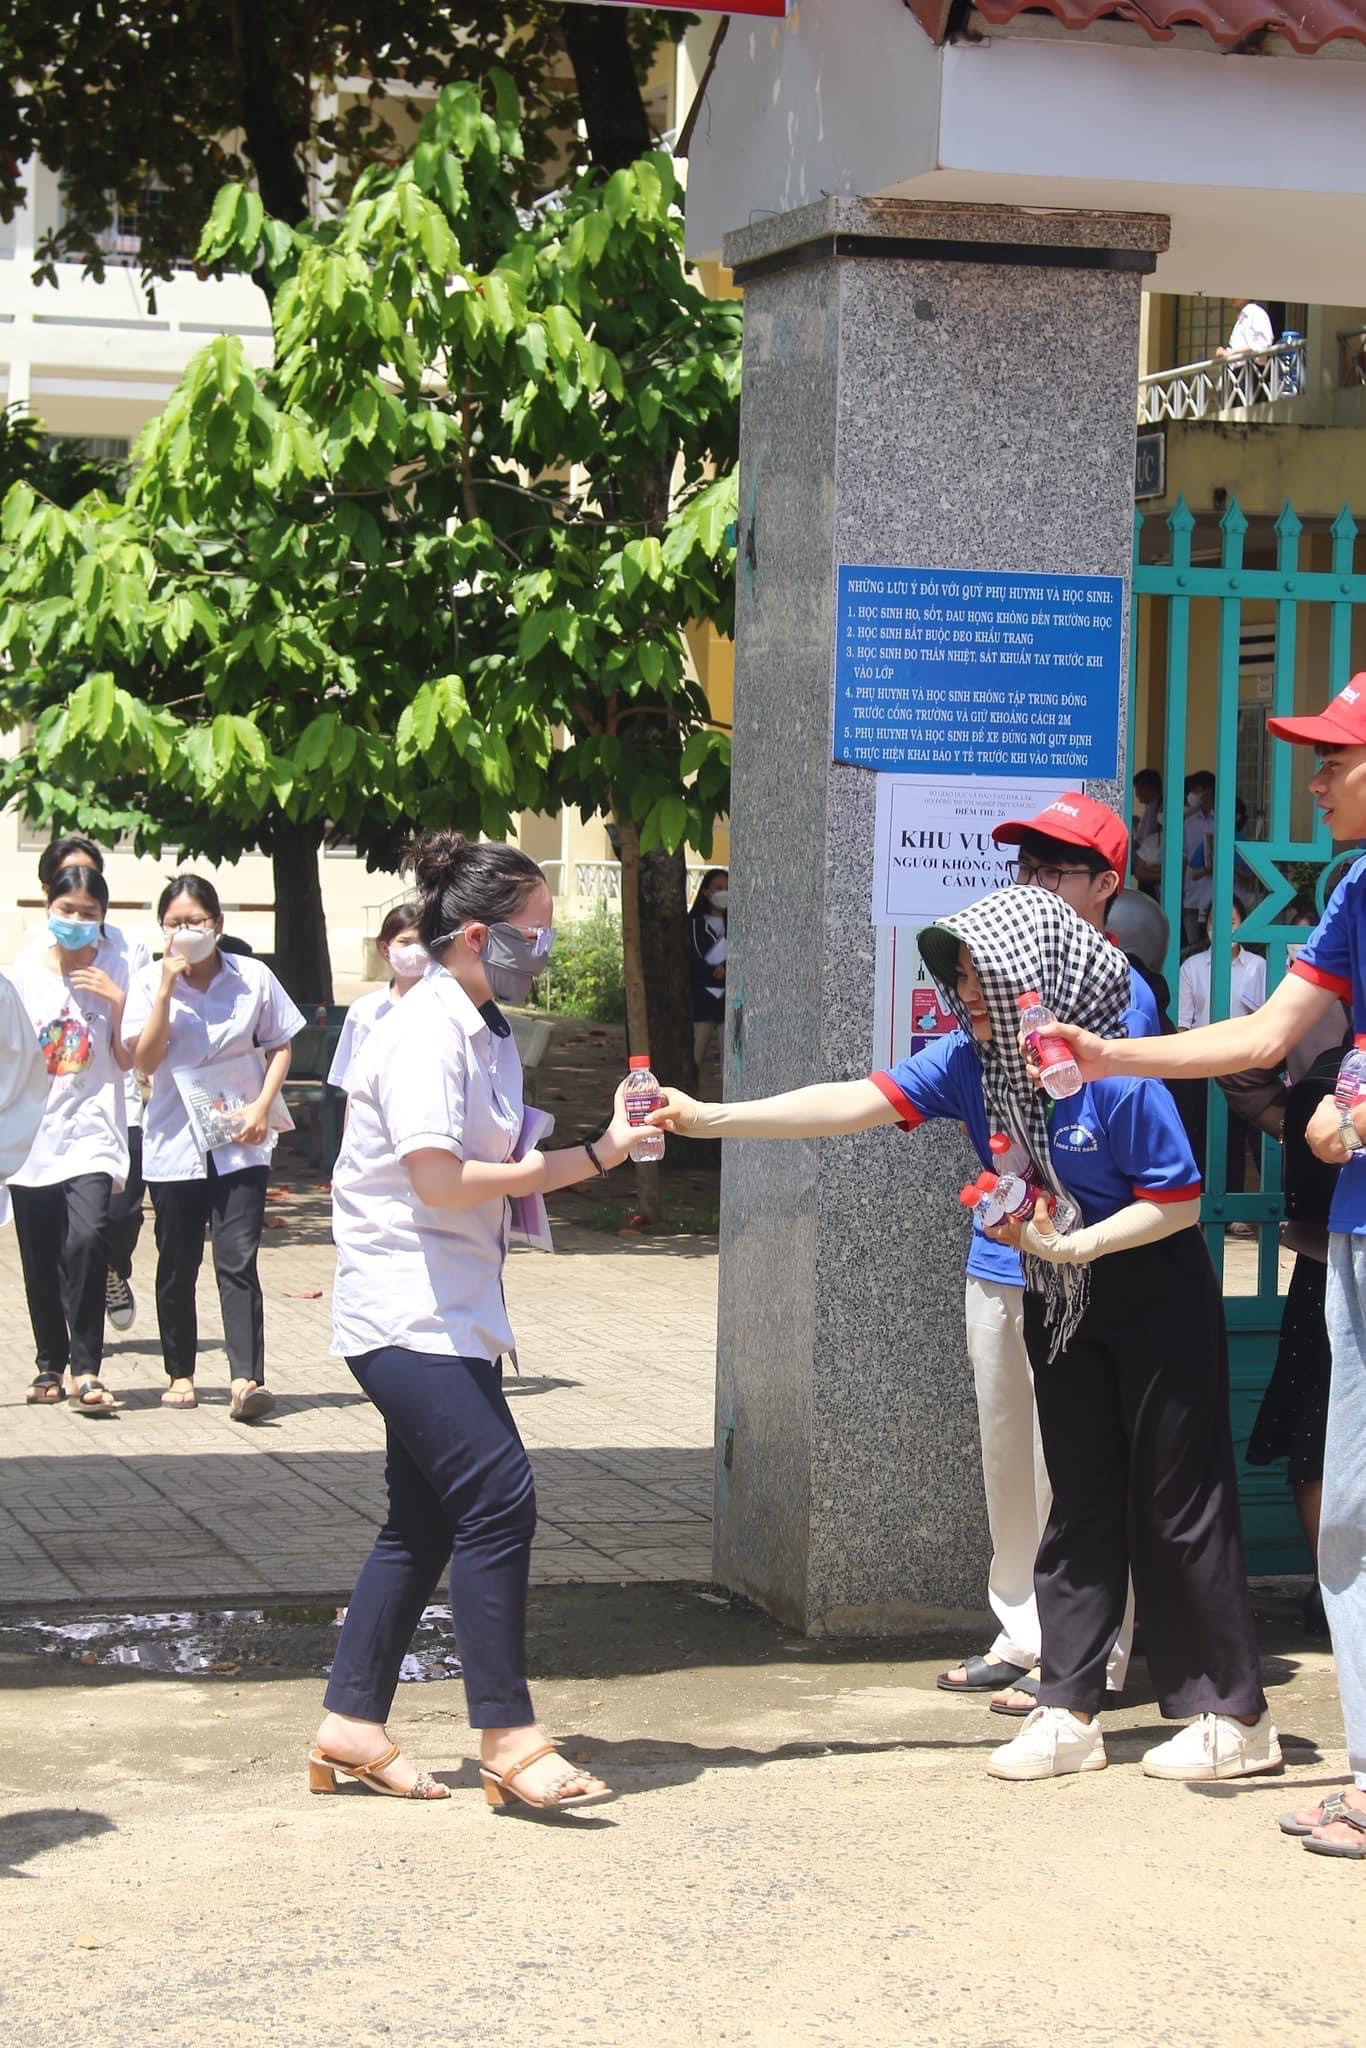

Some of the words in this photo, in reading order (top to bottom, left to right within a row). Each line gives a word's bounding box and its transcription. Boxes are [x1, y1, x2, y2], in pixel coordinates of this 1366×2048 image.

[848, 577, 884, 593] NHỮNG
[887, 580, 908, 595] LƯU
[911, 579, 918, 595] Ý
[920, 577, 939, 596] ĐỐI
[942, 580, 959, 597] VỚI
[962, 582, 983, 600] QUÝ
[986, 586, 1006, 602] PHỤ
[1009, 587, 1044, 600] HUYNH
[1047, 585, 1060, 601] VÀ
[1063, 589, 1084, 605] HỌC
[1087, 591, 1113, 603] SINH:
[848, 606, 855, 617] 1.
[858, 606, 878, 621] HỌC
[881, 608, 902, 619] SINH
[905, 608, 921, 621] HO,
[924, 604, 943, 622] SỐT,
[946, 610, 965, 622] ĐAU
[968, 611, 993, 626] HỌNG
[996, 610, 1029, 625] KHÔNG
[1031, 608, 1050, 625] ĐẾN
[1053, 612, 1090, 627] TRƯỜNG
[1093, 616, 1112, 631] HỌC
[846, 626, 855, 638] 2.
[857, 627, 878, 641] HỌC
[880, 628, 902, 639] SINH
[904, 622, 923, 640] BẮT
[925, 627, 951, 644] BUỘC
[953, 630, 972, 642] ĐEO
[975, 626, 1000, 643] KHẨU
[1003, 632, 1034, 645] TRANG
[846, 646, 855, 658] 3.
[857, 647, 877, 662] HỌC
[880, 648, 902, 659] SINH
[904, 648, 918, 660] ĐO
[920, 646, 945, 661] THÂN
[980, 648, 998, 663] SÁT
[1000, 647, 1032, 665] KHUẨN
[1034, 654, 1052, 665] TAY
[1053, 651, 1084, 666] TRƯỚC
[1086, 655, 1103, 667] KHI
[854, 664, 873, 679] VÀO
[875, 664, 894, 679] LỚP
[845, 687, 854, 698] 4.
[856, 687, 874, 702] PHỤ
[877, 688, 909, 700] HUYNH
[912, 686, 924, 701] VÀ
[926, 690, 946, 704] HỌC
[948, 691, 970, 702] SINH
[973, 689, 1005, 704] KHÔNG
[1008, 690, 1025, 707] TẬP
[1028, 693, 1058, 705] TRUNG
[1061, 692, 1087, 706] ĐÔNG
[853, 704, 884, 719] TRƯỚC
[916, 706, 953, 721] TRƯỜNG
[956, 707, 968, 722] VÀ
[971, 708, 988, 723] GIỮ
[990, 709, 1028, 724] KHOẢNG
[1031, 711, 1055, 725] CÁCH
[1058, 714, 1071, 726] 2M
[844, 727, 852, 739] 5.
[855, 728, 873, 742] PHỤ
[877, 728, 908, 740] HUYNH
[911, 726, 923, 741] VÀ
[926, 730, 945, 744] HỌC
[947, 731, 969, 742] SINH
[987, 732, 999, 743] XE
[1002, 729, 1027, 744] ĐÚNG
[1030, 731, 1046, 745] NƠI
[1048, 734, 1068, 748] QUY
[1069, 735, 1092, 749] ĐỊNH
[843, 747, 852, 759] 6.
[854, 747, 880, 762] THỰC
[882, 745, 905, 763] HIỆN
[907, 749, 930, 761] KHAI
[932, 747, 952, 761] BÁO
[954, 751, 960, 761] Y
[962, 745, 974, 762] TẾ
[977, 749, 1009, 764] TRƯỚC
[1011, 752, 1027, 764] KHI
[1029, 749, 1048, 765] VÀO
[1051, 751, 1088, 766] TRƯỜNG
[901, 830, 952, 850] KHU
[894, 855, 937, 869] NGƯỜI
[943, 857, 991, 871] KHÔNG
[981, 875, 1011, 888] VÀO
